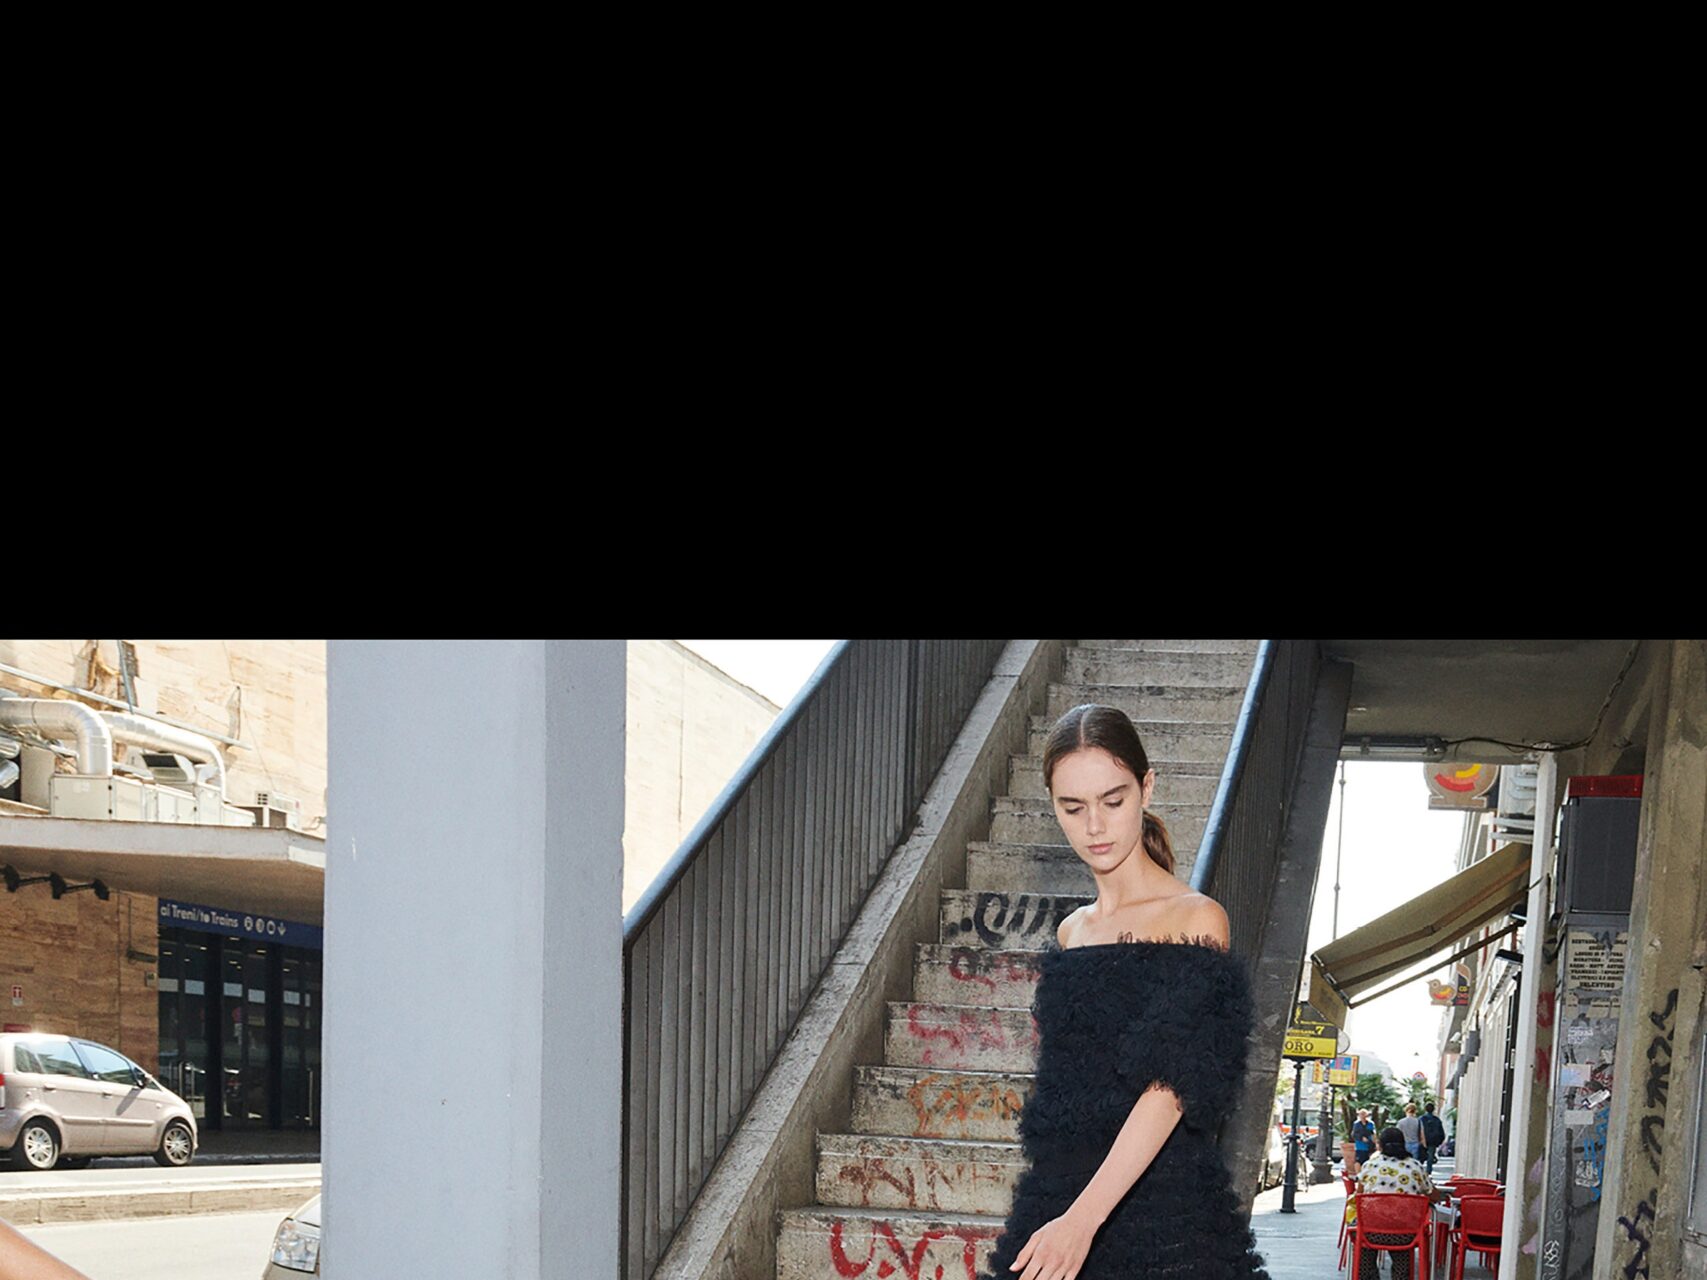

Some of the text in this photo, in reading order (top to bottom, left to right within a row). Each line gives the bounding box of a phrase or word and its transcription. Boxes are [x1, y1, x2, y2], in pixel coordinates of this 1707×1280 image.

[160, 903, 170, 917] ai
[211, 911, 239, 928] Trains
[1285, 1041, 1314, 1052] ORO
